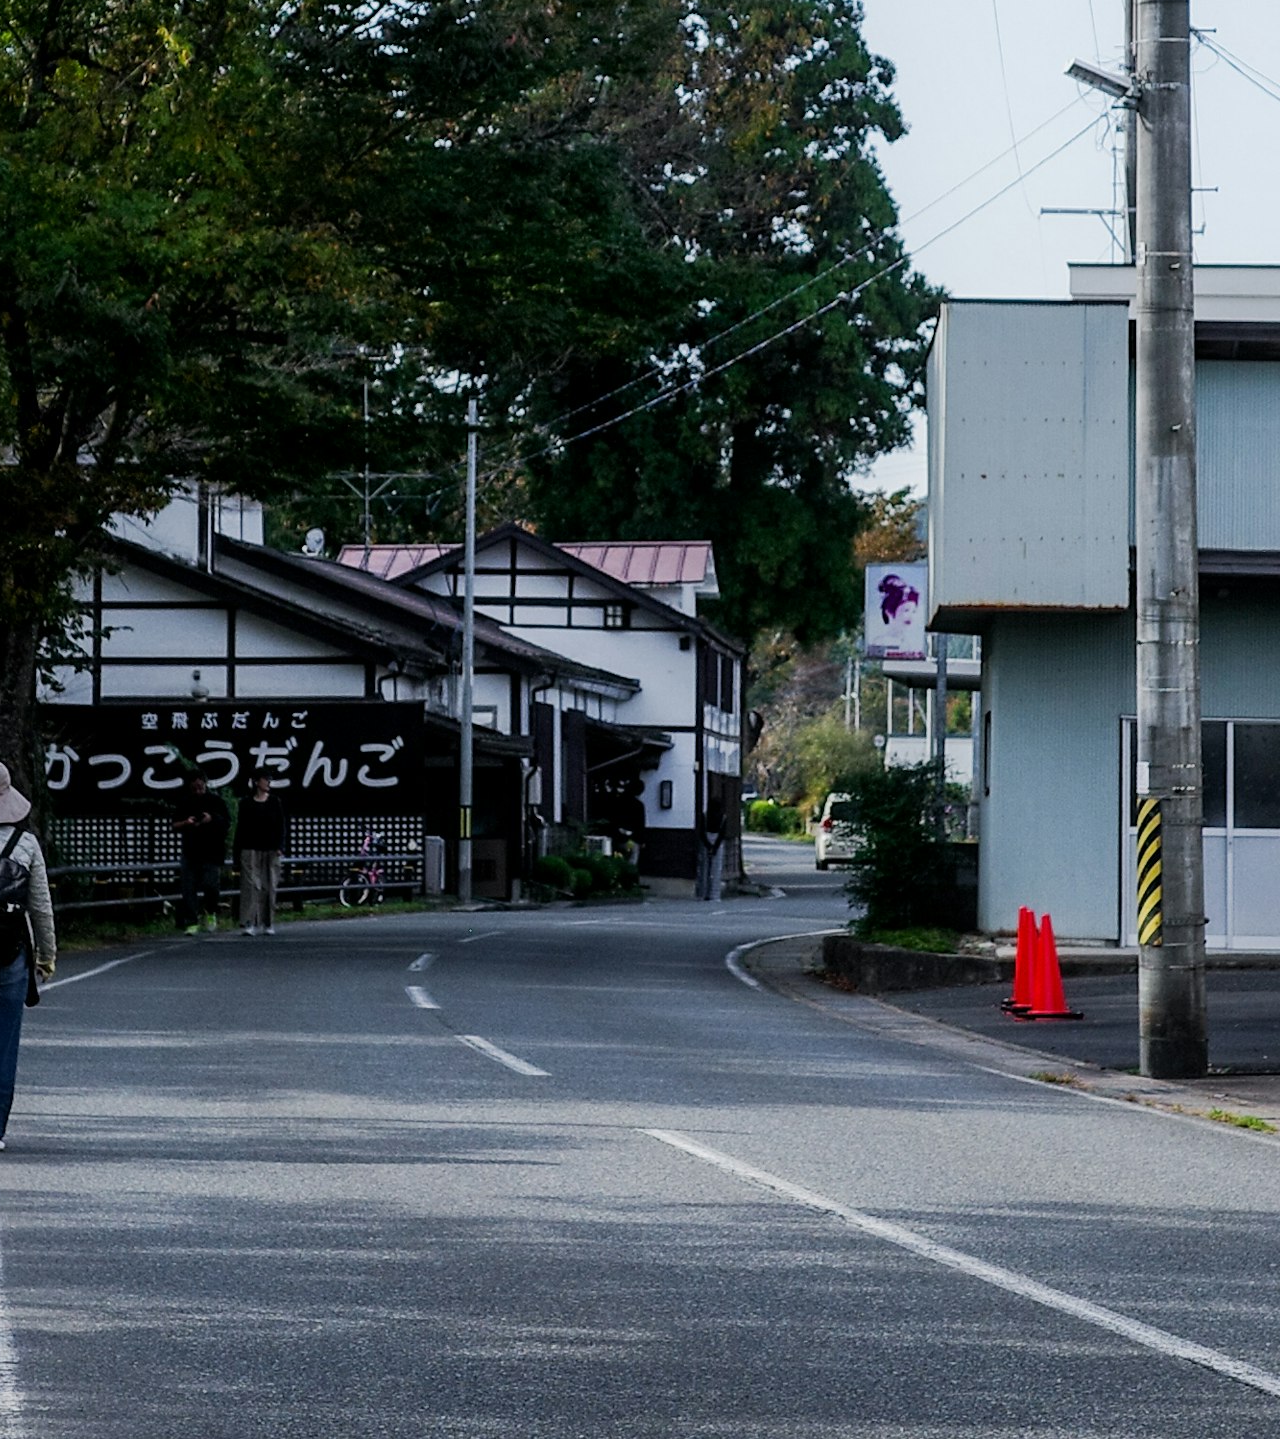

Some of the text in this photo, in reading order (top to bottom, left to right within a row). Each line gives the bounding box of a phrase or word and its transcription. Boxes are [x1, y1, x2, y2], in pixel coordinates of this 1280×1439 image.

[140, 710, 309, 731] 空飛ぶだんご
